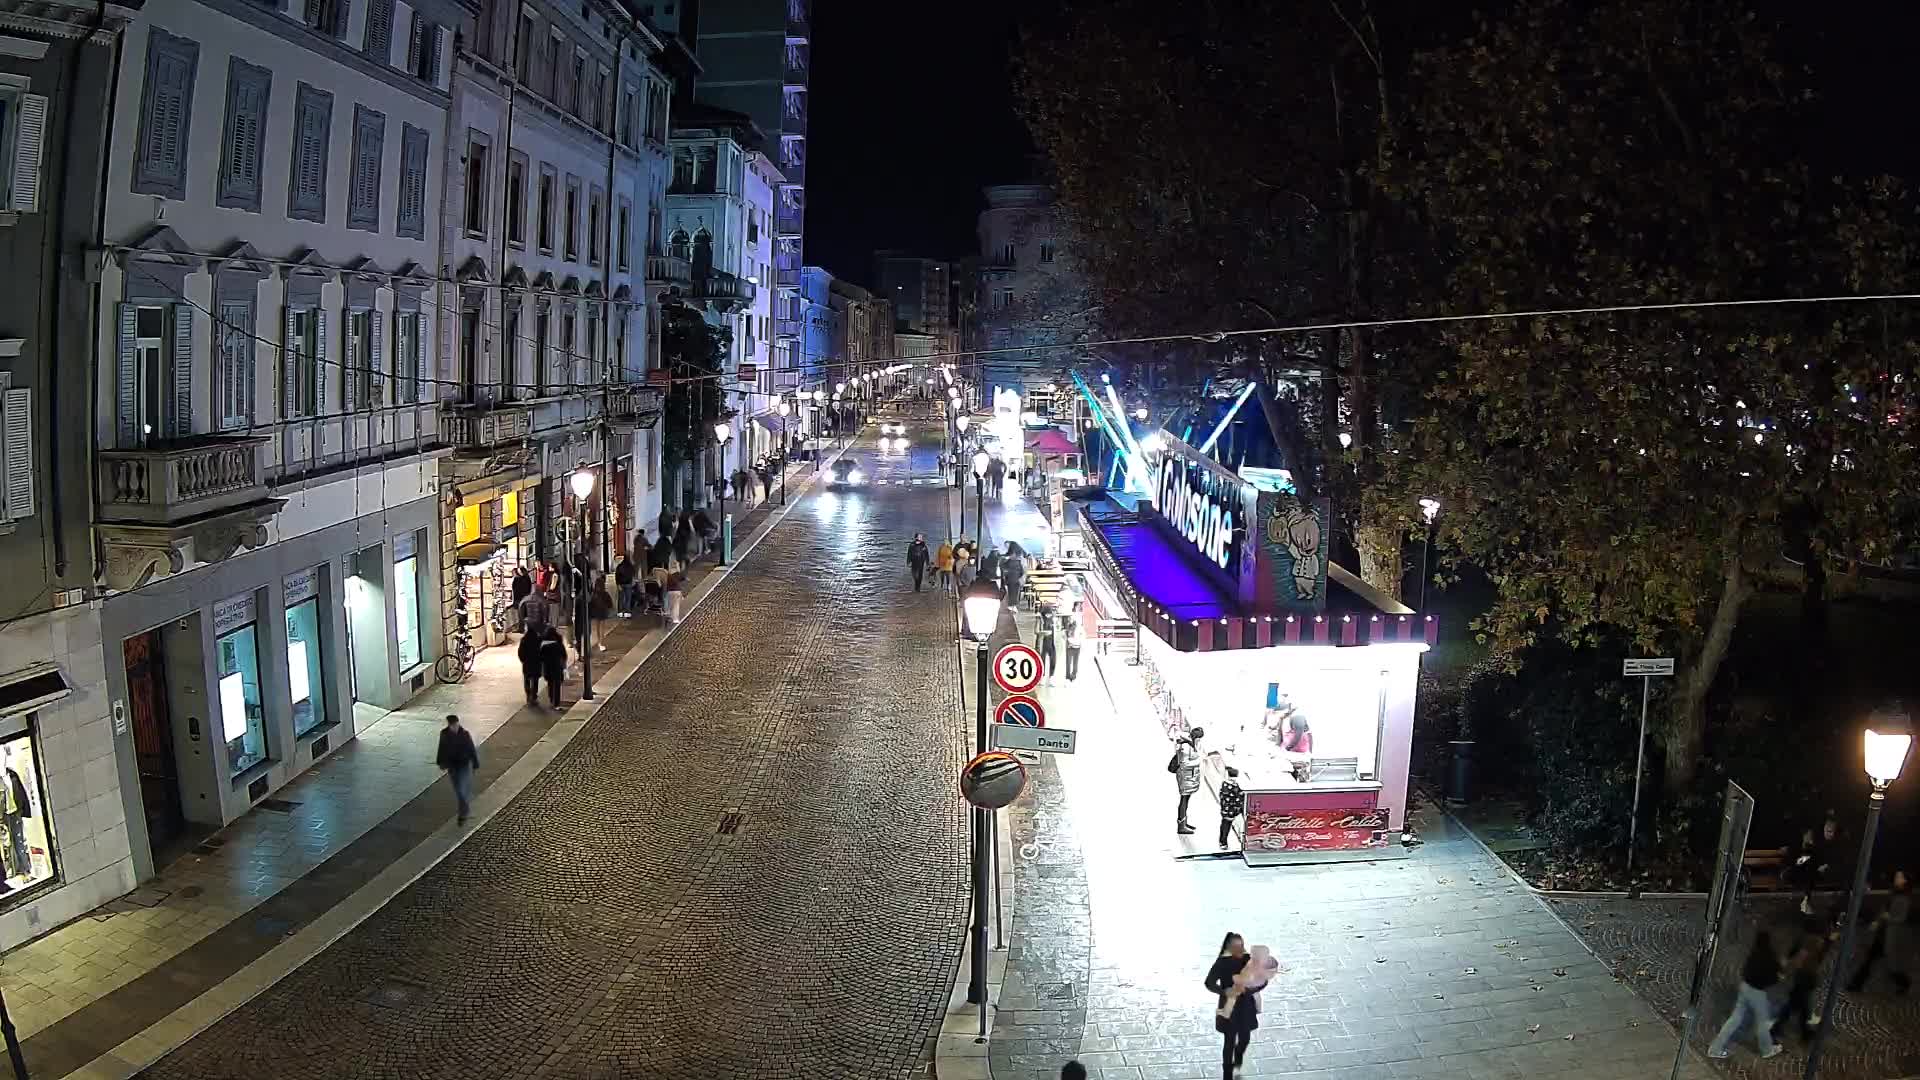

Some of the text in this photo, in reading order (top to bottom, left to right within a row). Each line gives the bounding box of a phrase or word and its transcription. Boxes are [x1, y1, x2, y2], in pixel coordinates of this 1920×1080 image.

[1162, 459, 1233, 569] Golosone
[1005, 657, 1033, 680] 30
[1038, 737, 1069, 748] Dante
